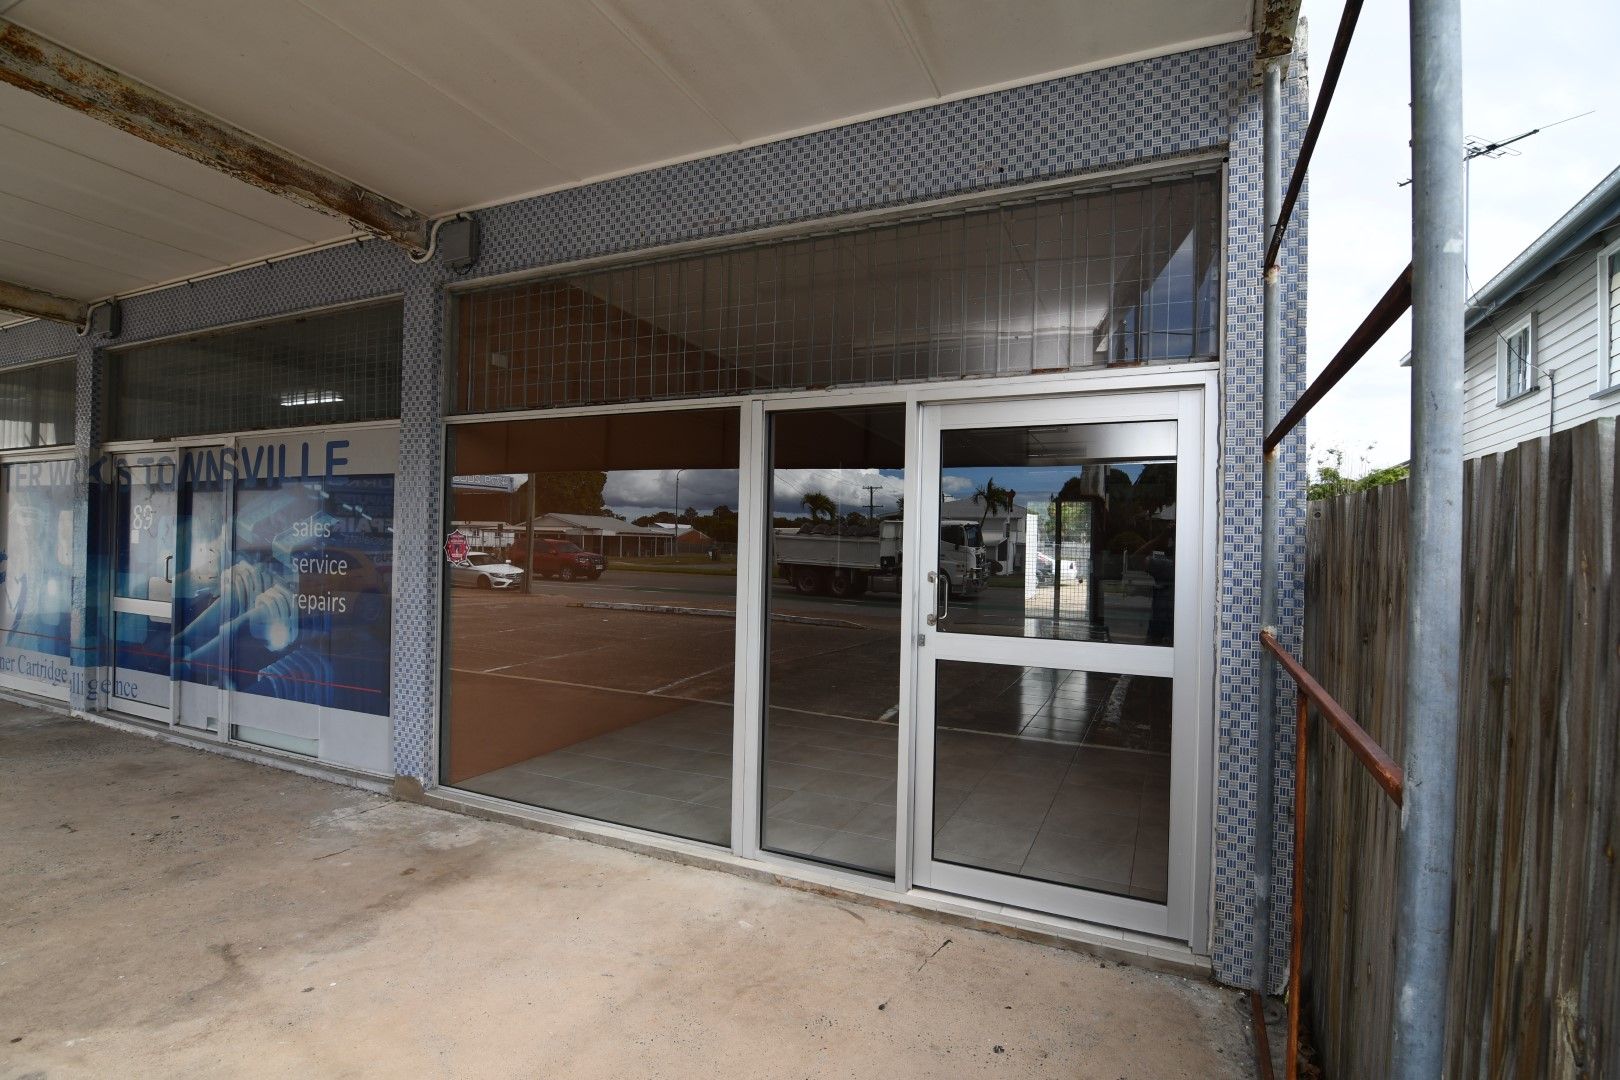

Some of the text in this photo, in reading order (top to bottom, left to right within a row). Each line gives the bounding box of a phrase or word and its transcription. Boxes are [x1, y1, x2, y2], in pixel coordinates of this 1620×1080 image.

[137, 440, 350, 492] TOWNSVILLE
[292, 516, 331, 538] sales
[291, 554, 348, 576] service
[291, 592, 347, 615] repairs
[18, 654, 67, 686] Cartridge
